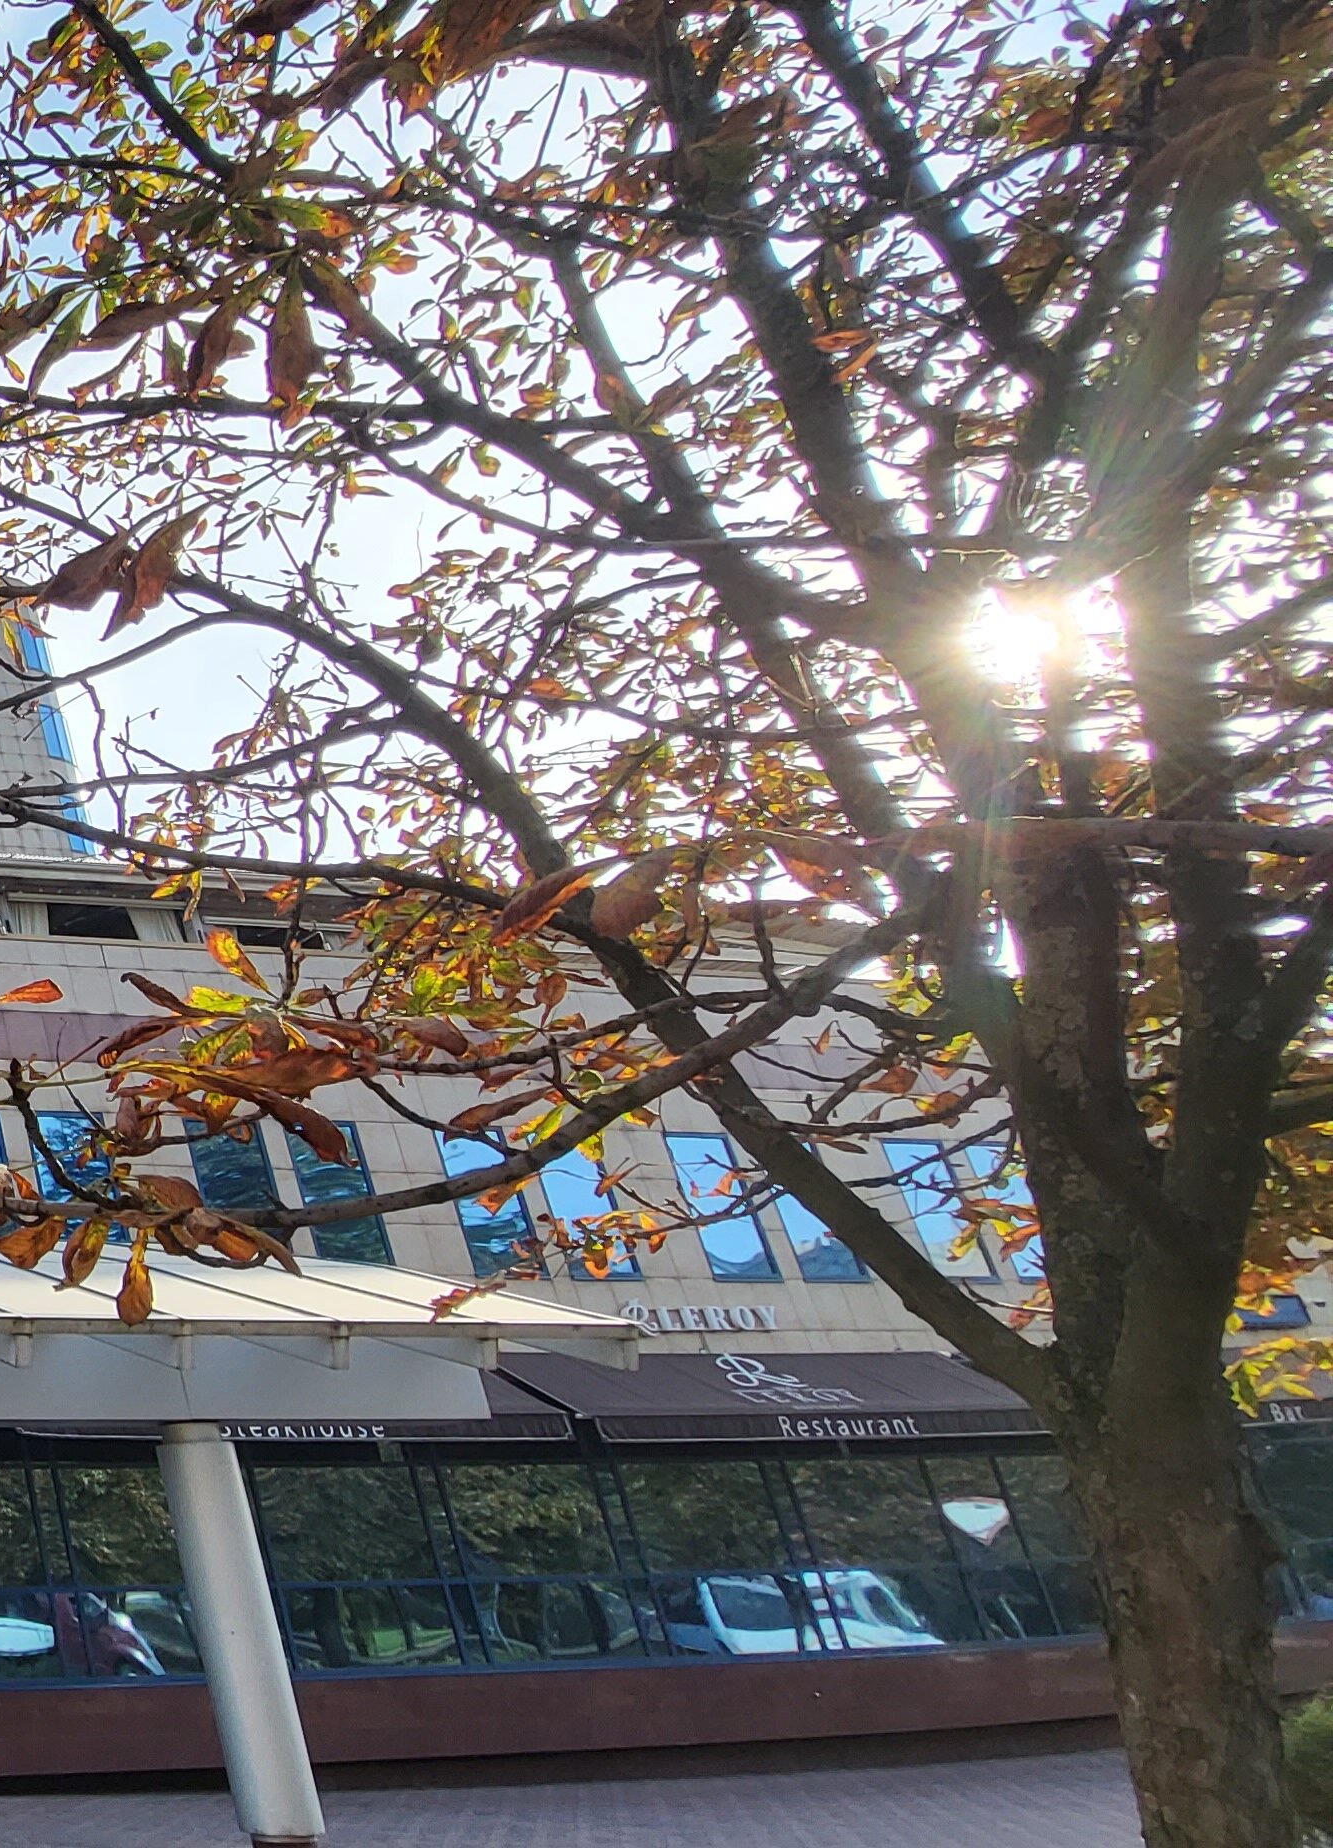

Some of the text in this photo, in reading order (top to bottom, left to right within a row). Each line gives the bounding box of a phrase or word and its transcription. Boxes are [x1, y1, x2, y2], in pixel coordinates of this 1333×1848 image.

[656, 1305, 777, 1331] LEROY
[1270, 1402, 1304, 1422] Bar
[778, 1415, 919, 1438] Restaurant
